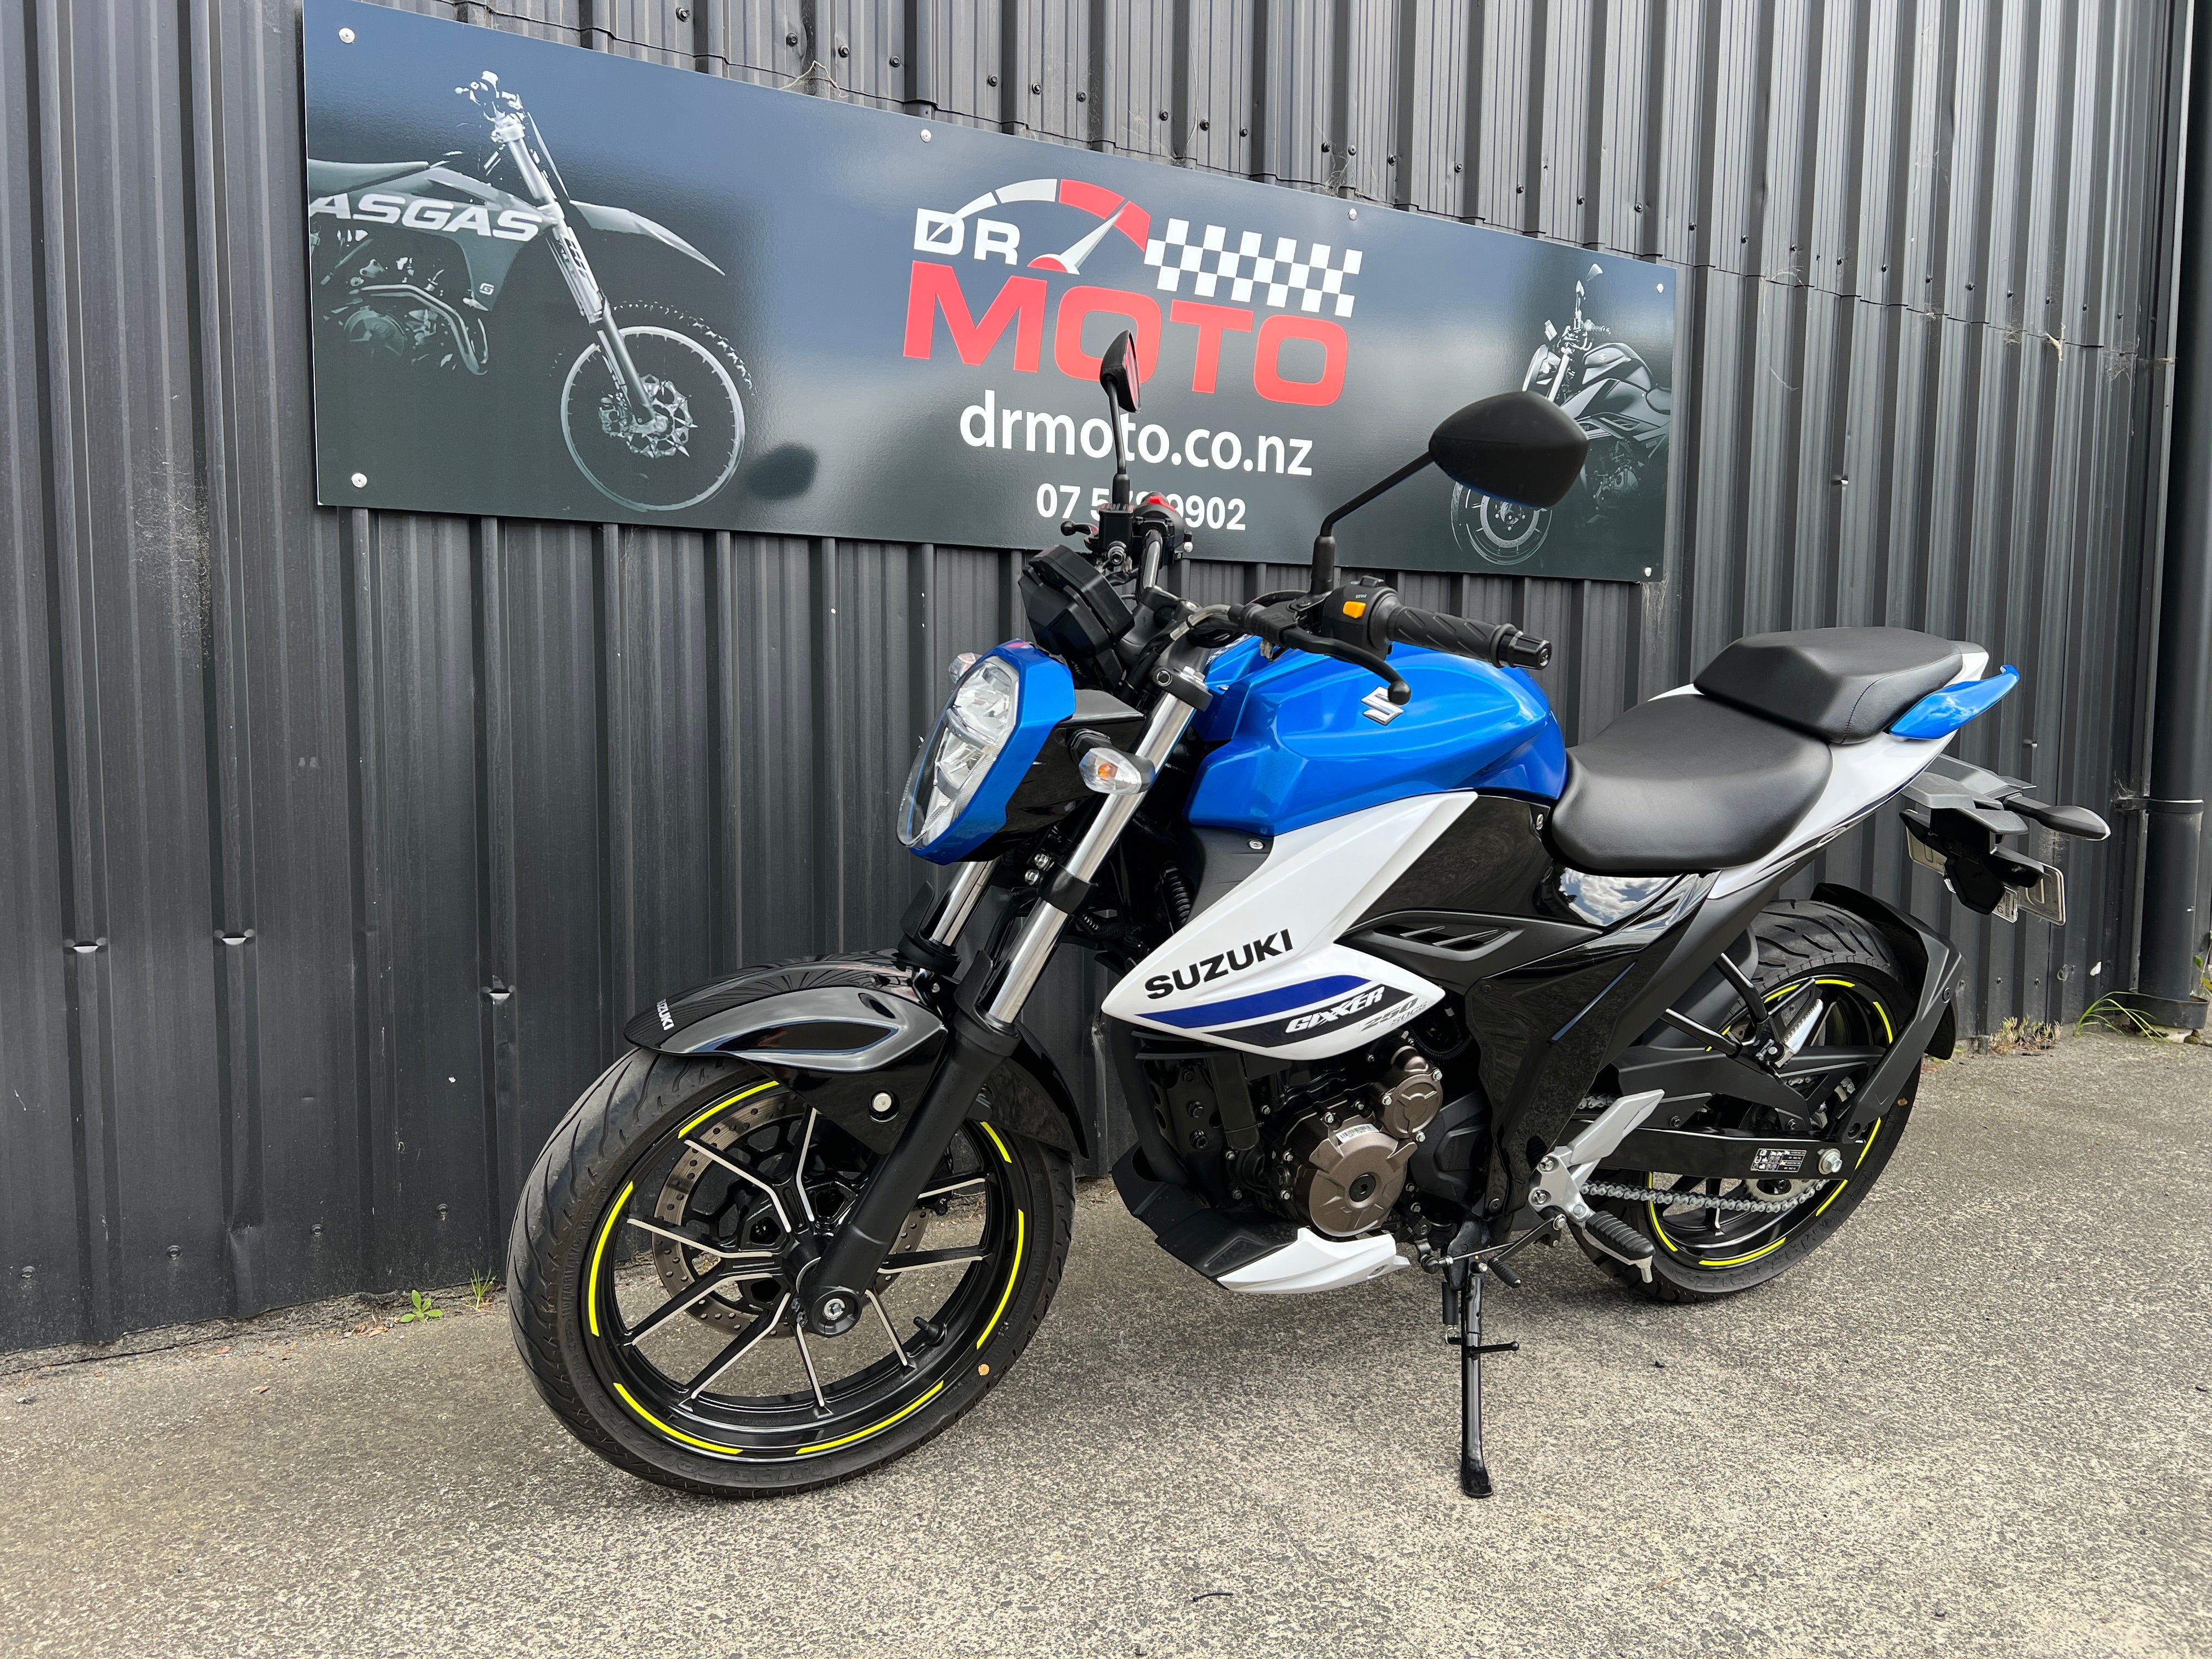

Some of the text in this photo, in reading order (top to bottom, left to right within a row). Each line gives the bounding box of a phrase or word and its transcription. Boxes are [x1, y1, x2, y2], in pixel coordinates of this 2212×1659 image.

[914, 208, 1021, 266] DR
[903, 259, 1349, 407] MOTO
[960, 390, 1313, 476] drmoto.co.nz
[1036, 483, 1081, 519] 07
[1144, 928, 1294, 1000] SUZUKI
[1285, 986, 1386, 1034] GIXXER
[1361, 997, 1419, 1032] 250
